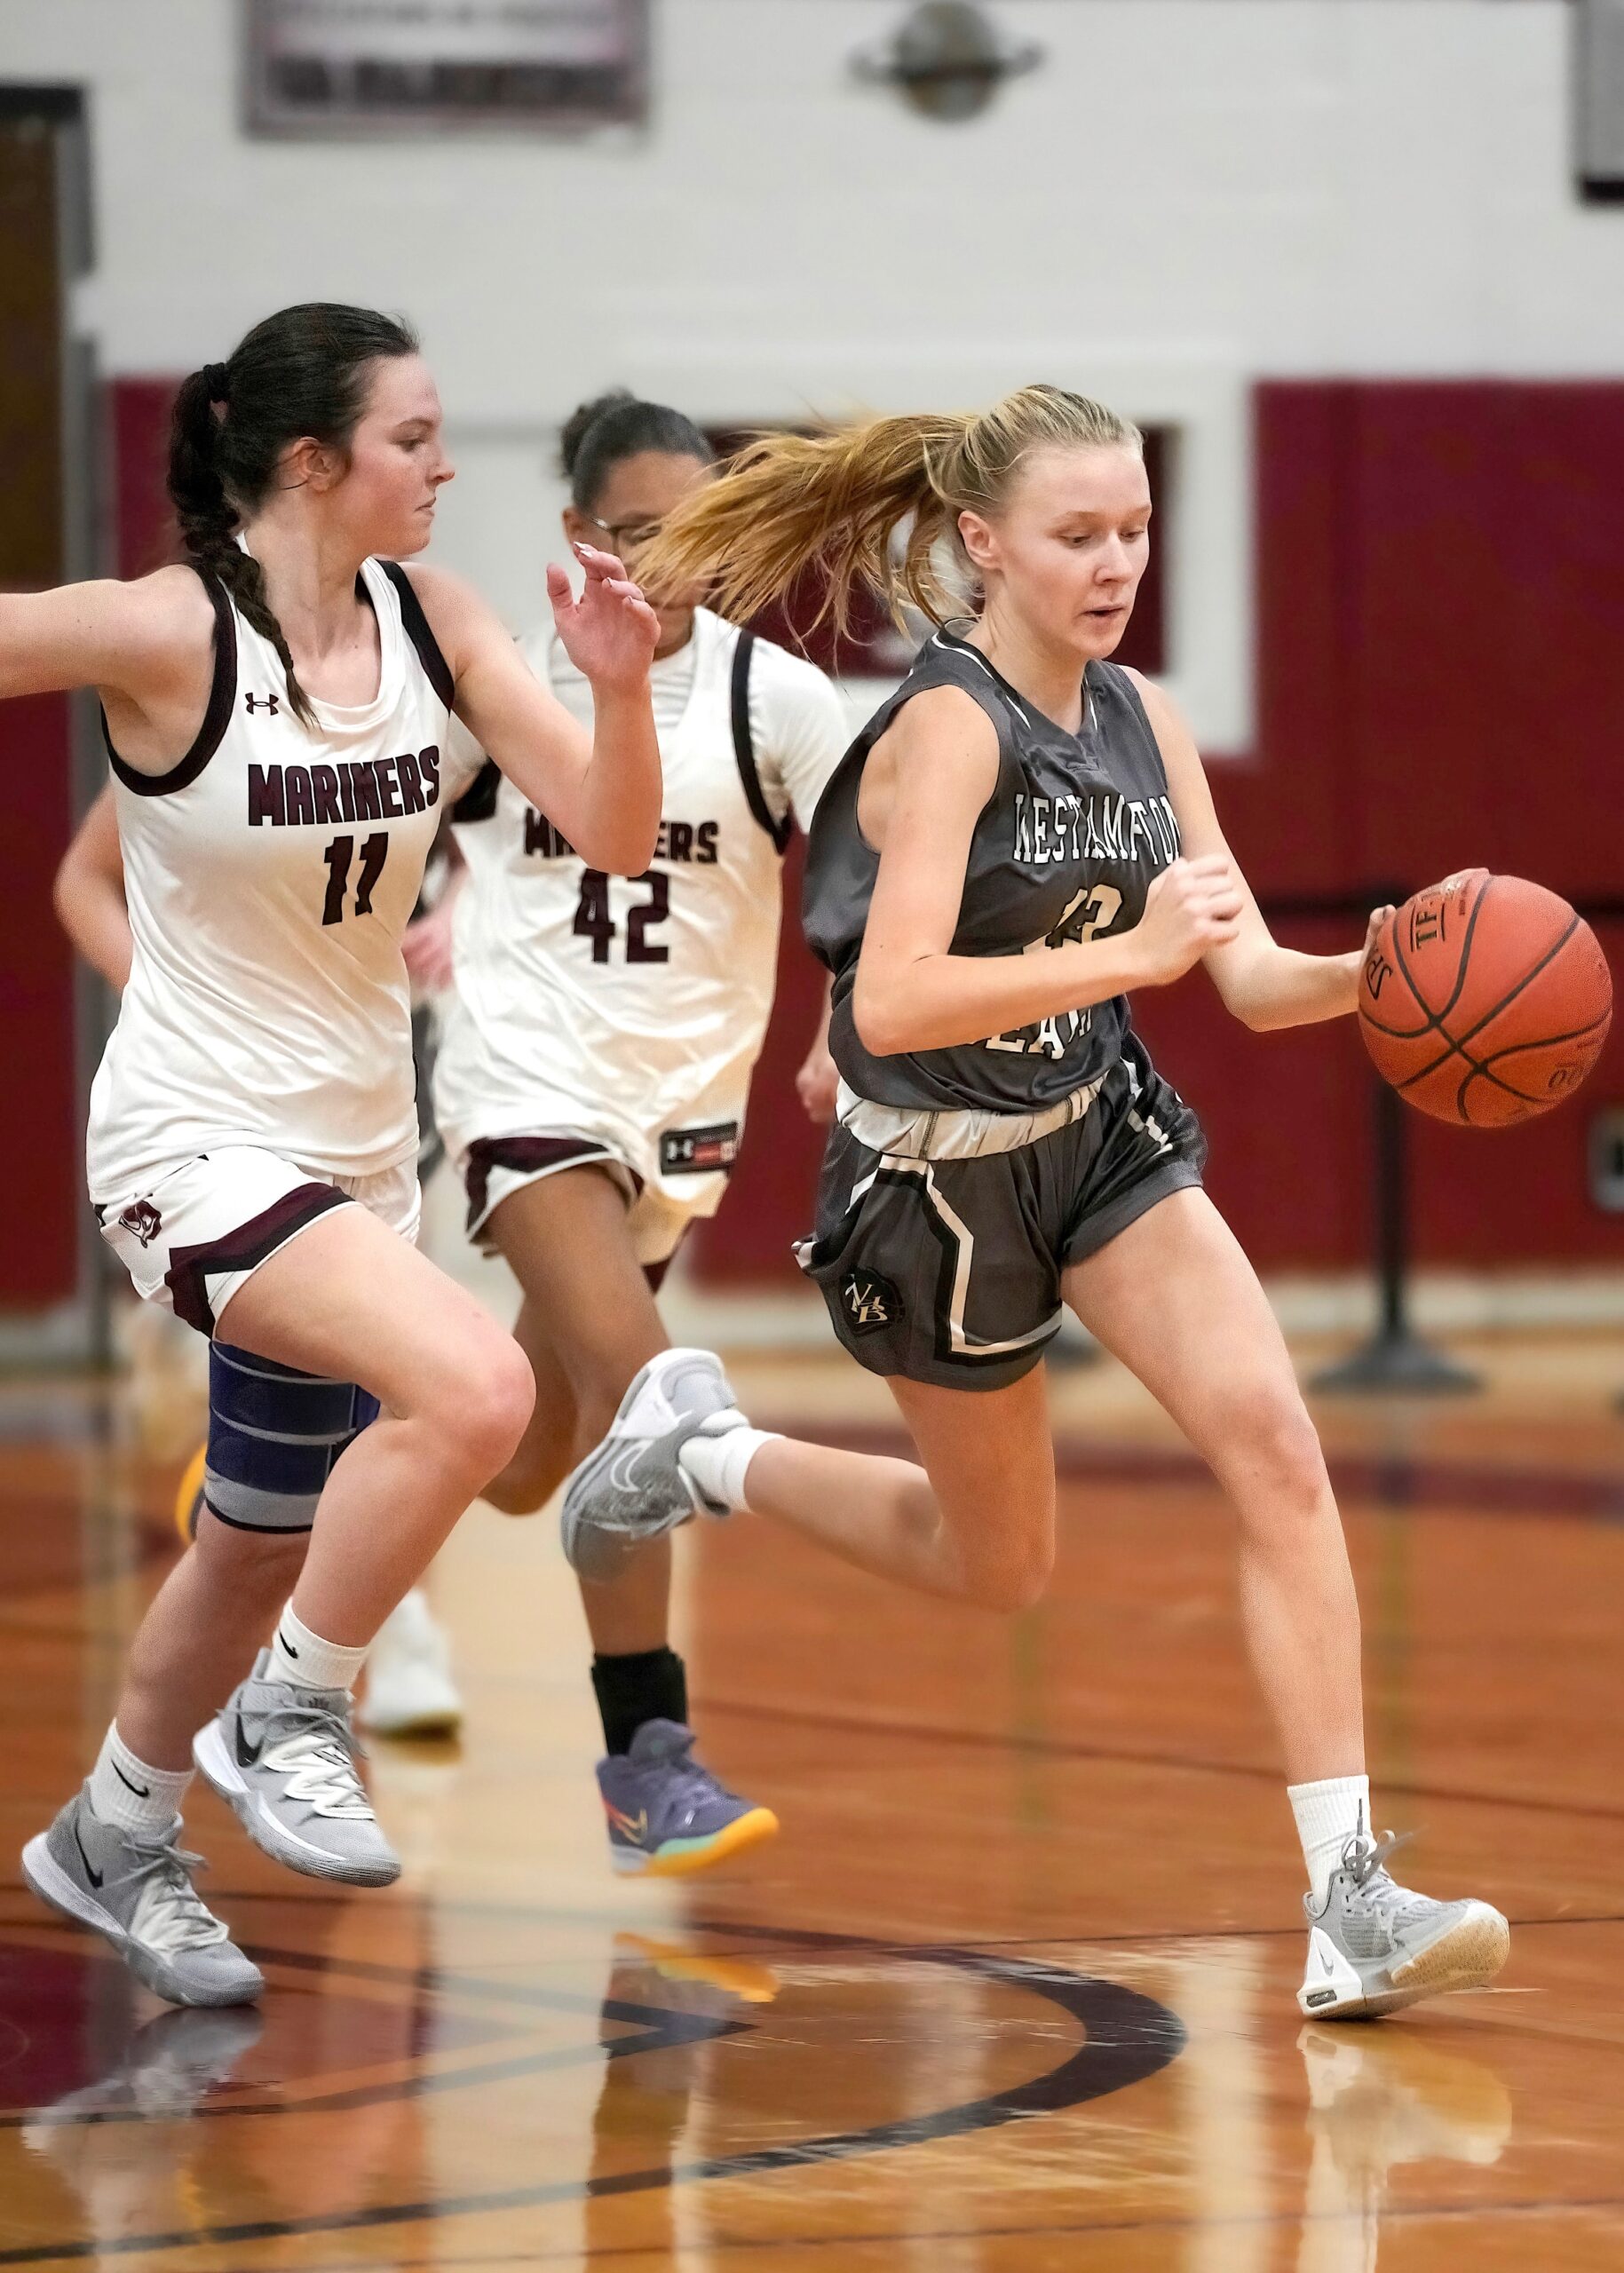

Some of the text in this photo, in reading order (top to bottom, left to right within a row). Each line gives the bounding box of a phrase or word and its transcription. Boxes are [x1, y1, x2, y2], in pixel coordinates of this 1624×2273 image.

[248, 745, 440, 827] MARINERS
[322, 831, 389, 924] 11
[574, 867, 669, 963] 42
